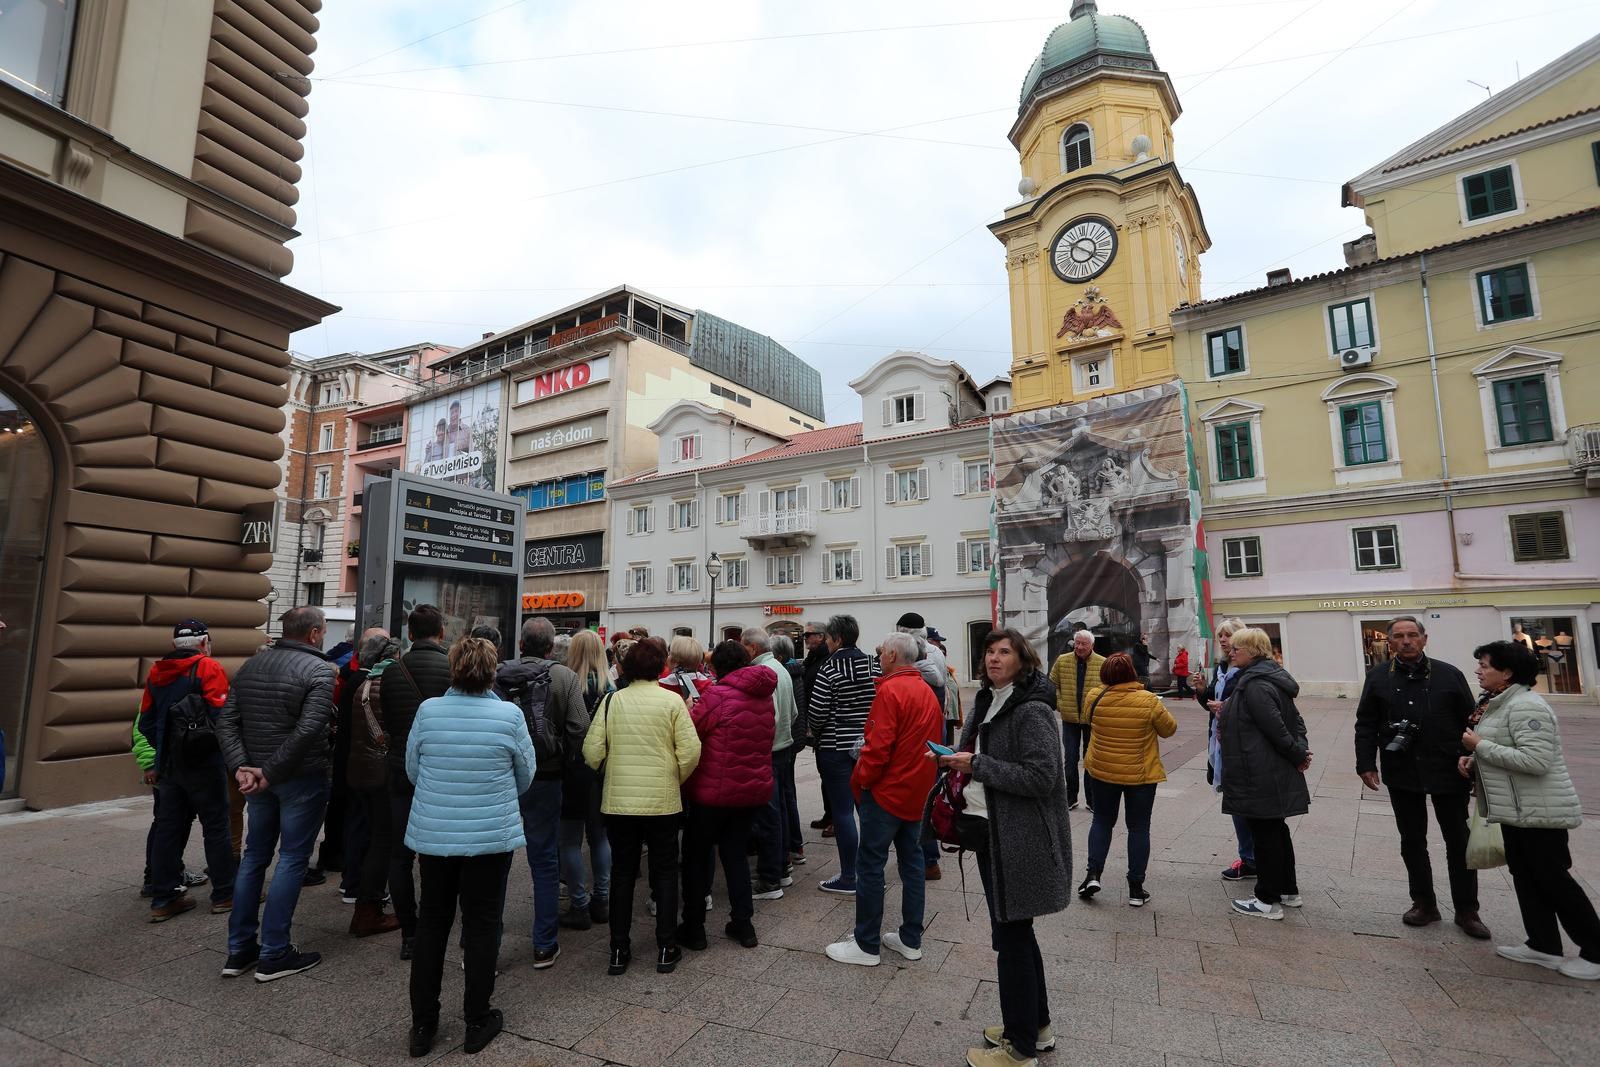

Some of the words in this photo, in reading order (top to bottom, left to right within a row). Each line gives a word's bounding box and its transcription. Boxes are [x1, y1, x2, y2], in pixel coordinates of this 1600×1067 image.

[534, 362, 591, 400] NKD
[530, 431, 551, 451] naš
[565, 424, 593, 446] dom
[423, 456, 480, 476] #TvojeMisto
[590, 482, 605, 491] TED
[242, 521, 273, 544] ZARA
[469, 533, 490, 541] Cathedral
[527, 544, 586, 567] CENTRA
[522, 592, 585, 609] KORZO
[1318, 599, 1401, 608] intimissimi
[772, 605, 804, 615] Müller
